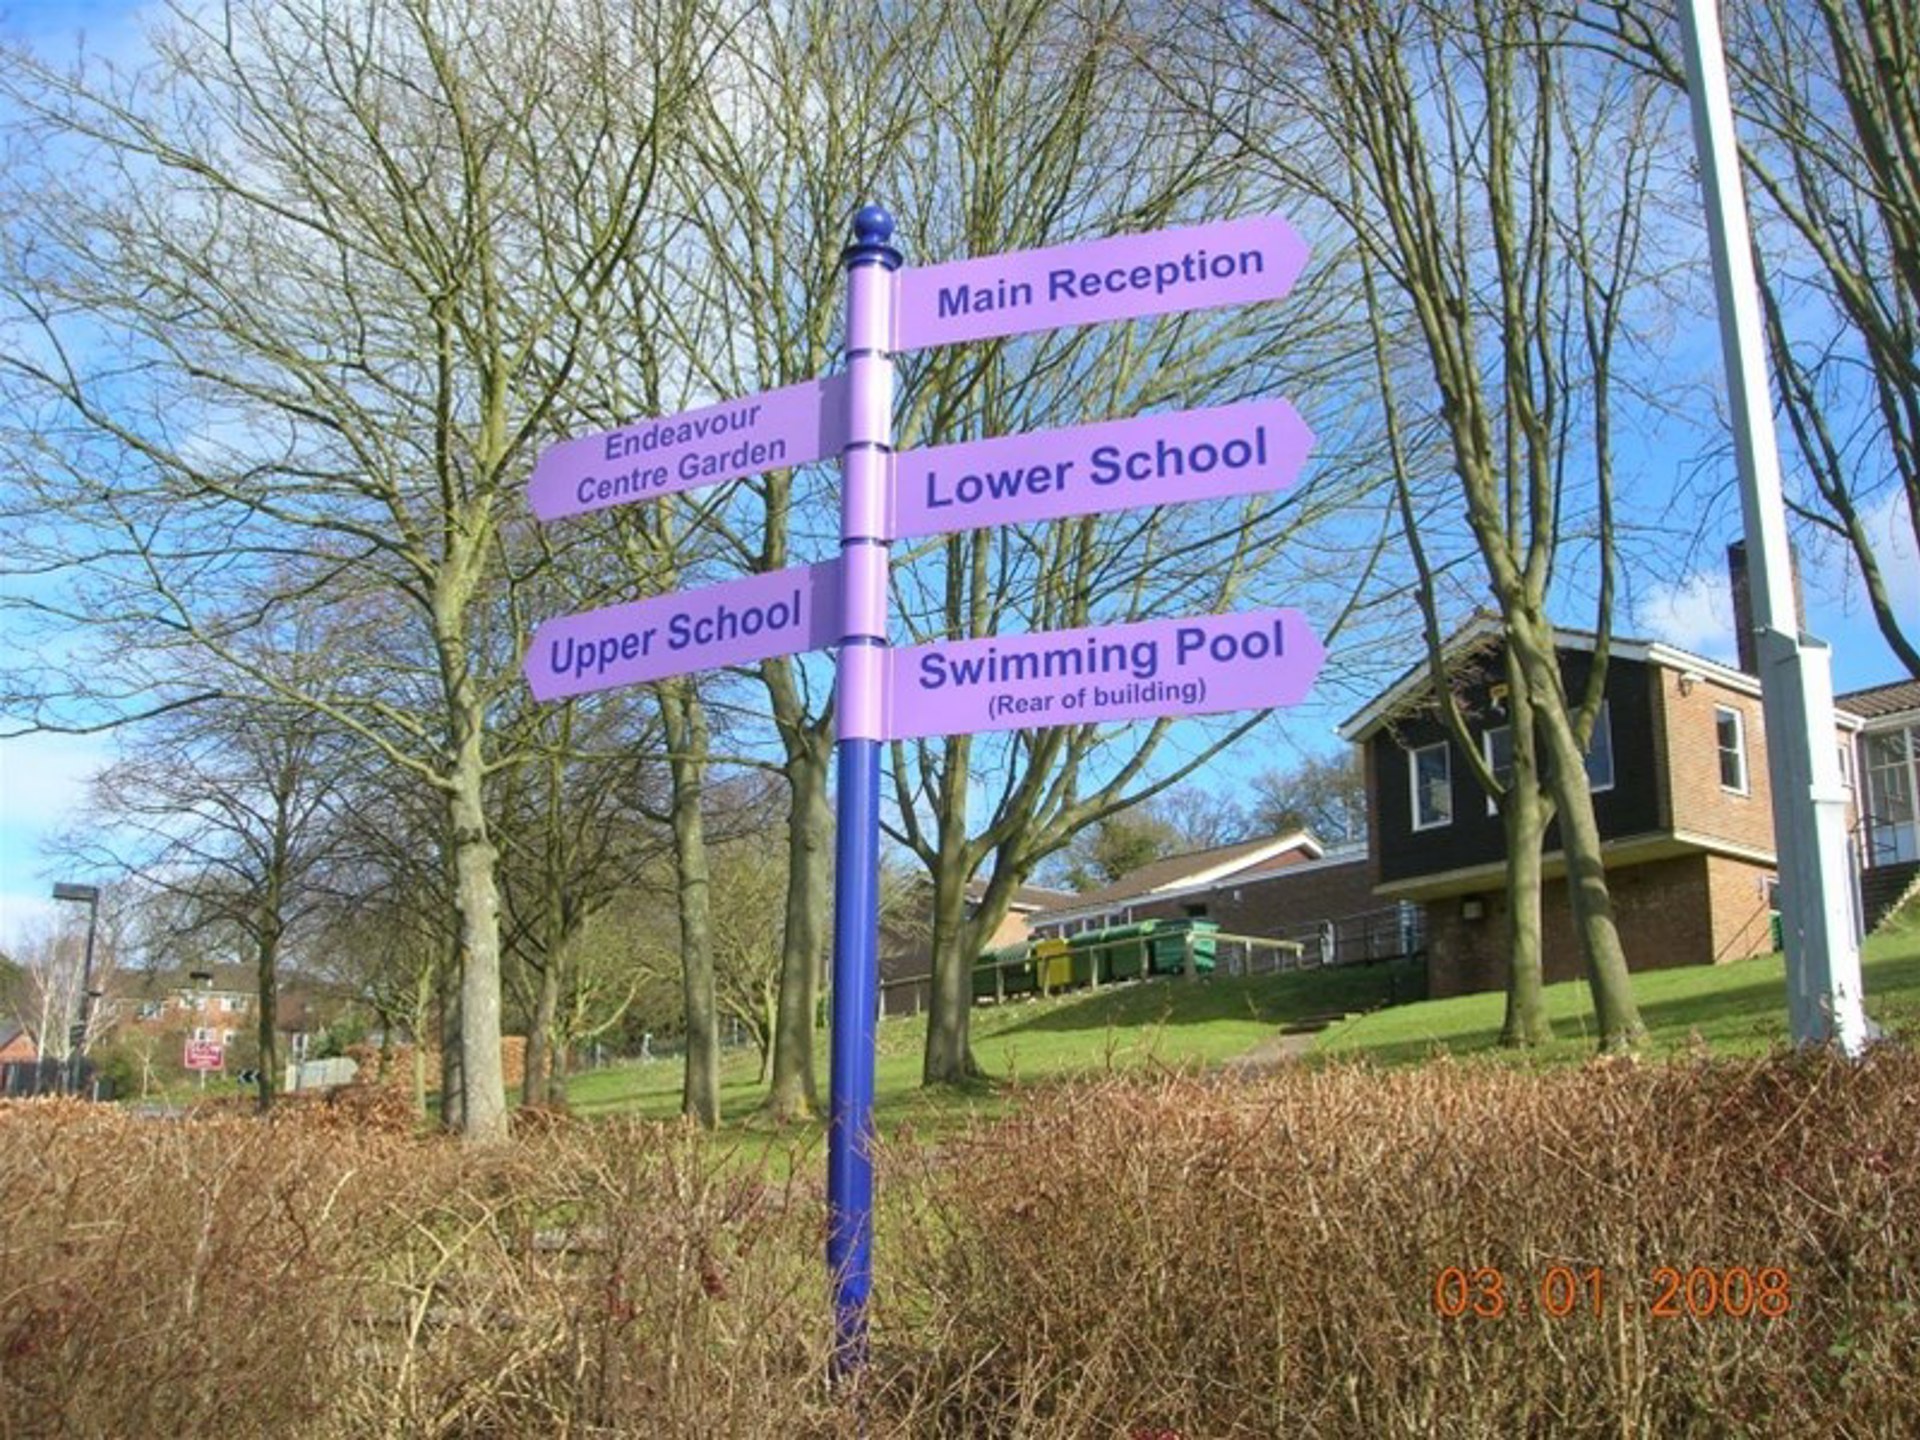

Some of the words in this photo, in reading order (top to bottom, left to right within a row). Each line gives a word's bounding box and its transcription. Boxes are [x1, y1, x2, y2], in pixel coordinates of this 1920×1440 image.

[938, 278, 1032, 318] Main
[1048, 249, 1264, 301] Reception
[604, 405, 762, 460] Endeavour
[577, 466, 668, 504] Centre
[678, 438, 786, 480] Garden
[926, 461, 1073, 509] Lower
[1090, 426, 1267, 486] School
[550, 627, 657, 678] Upper
[667, 589, 801, 650] School
[918, 638, 1158, 690] Swimming
[1176, 620, 1284, 665] Pool
[988, 694, 1052, 720] (Rear
[1062, 687, 1086, 709] of
[1094, 677, 1207, 707] building)
